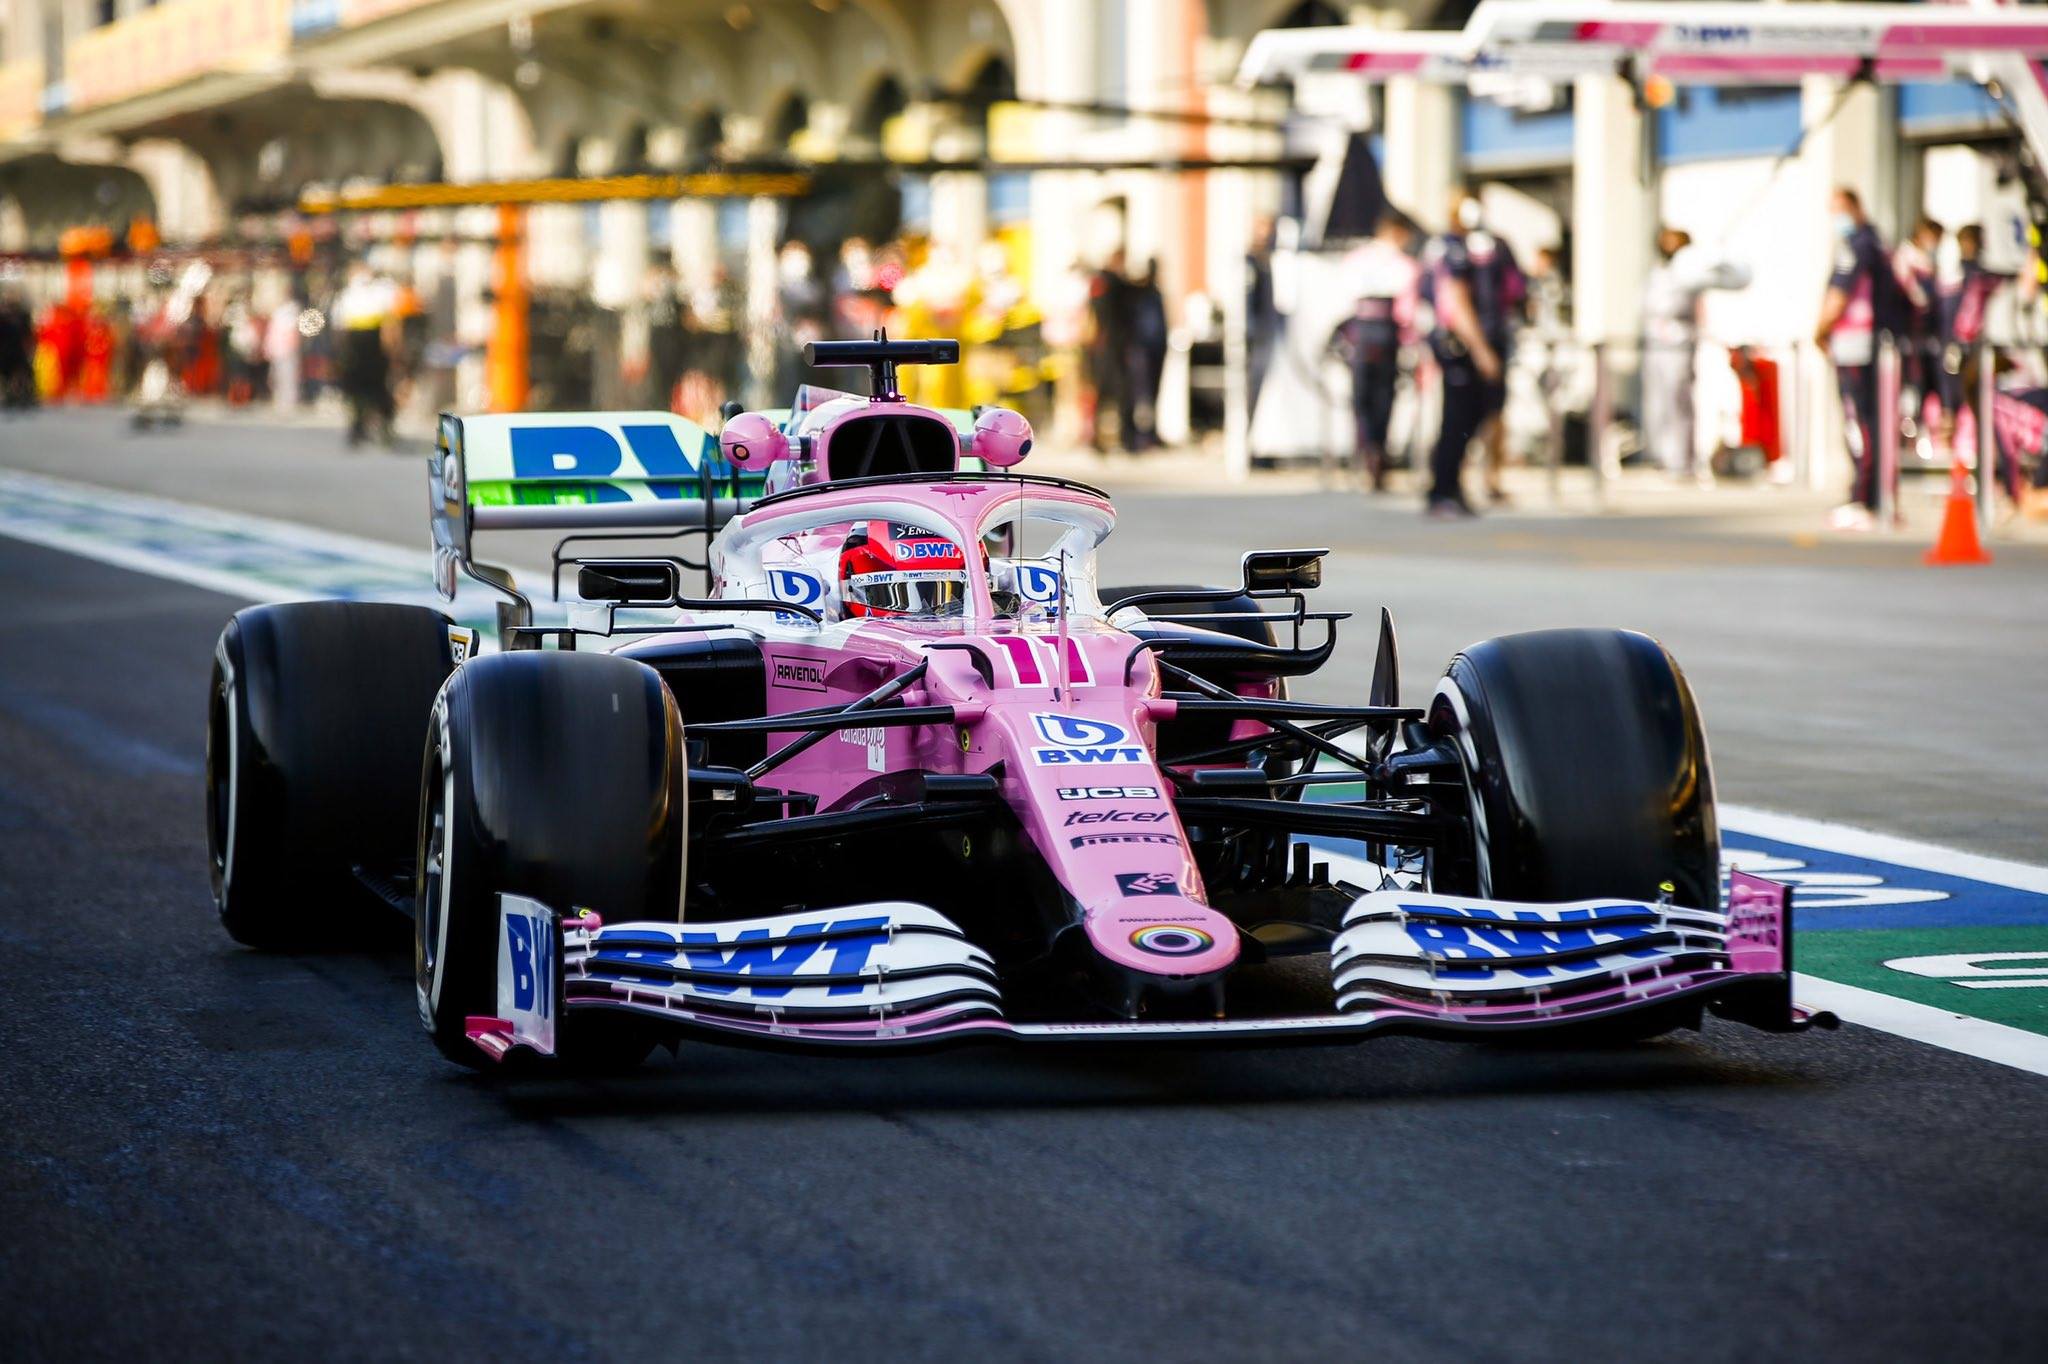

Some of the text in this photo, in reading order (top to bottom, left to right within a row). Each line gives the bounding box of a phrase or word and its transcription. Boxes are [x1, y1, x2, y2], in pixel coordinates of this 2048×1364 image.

[915, 543, 954, 557] BWT
[874, 574, 893, 583] BWT
[777, 664, 823, 684] RAVENOL
[1038, 748, 1143, 764] BWT
[1058, 787, 1158, 800] JCB
[1064, 810, 1170, 827] telcel
[1397, 904, 1662, 981] BWT
[580, 916, 891, 998] BWT
